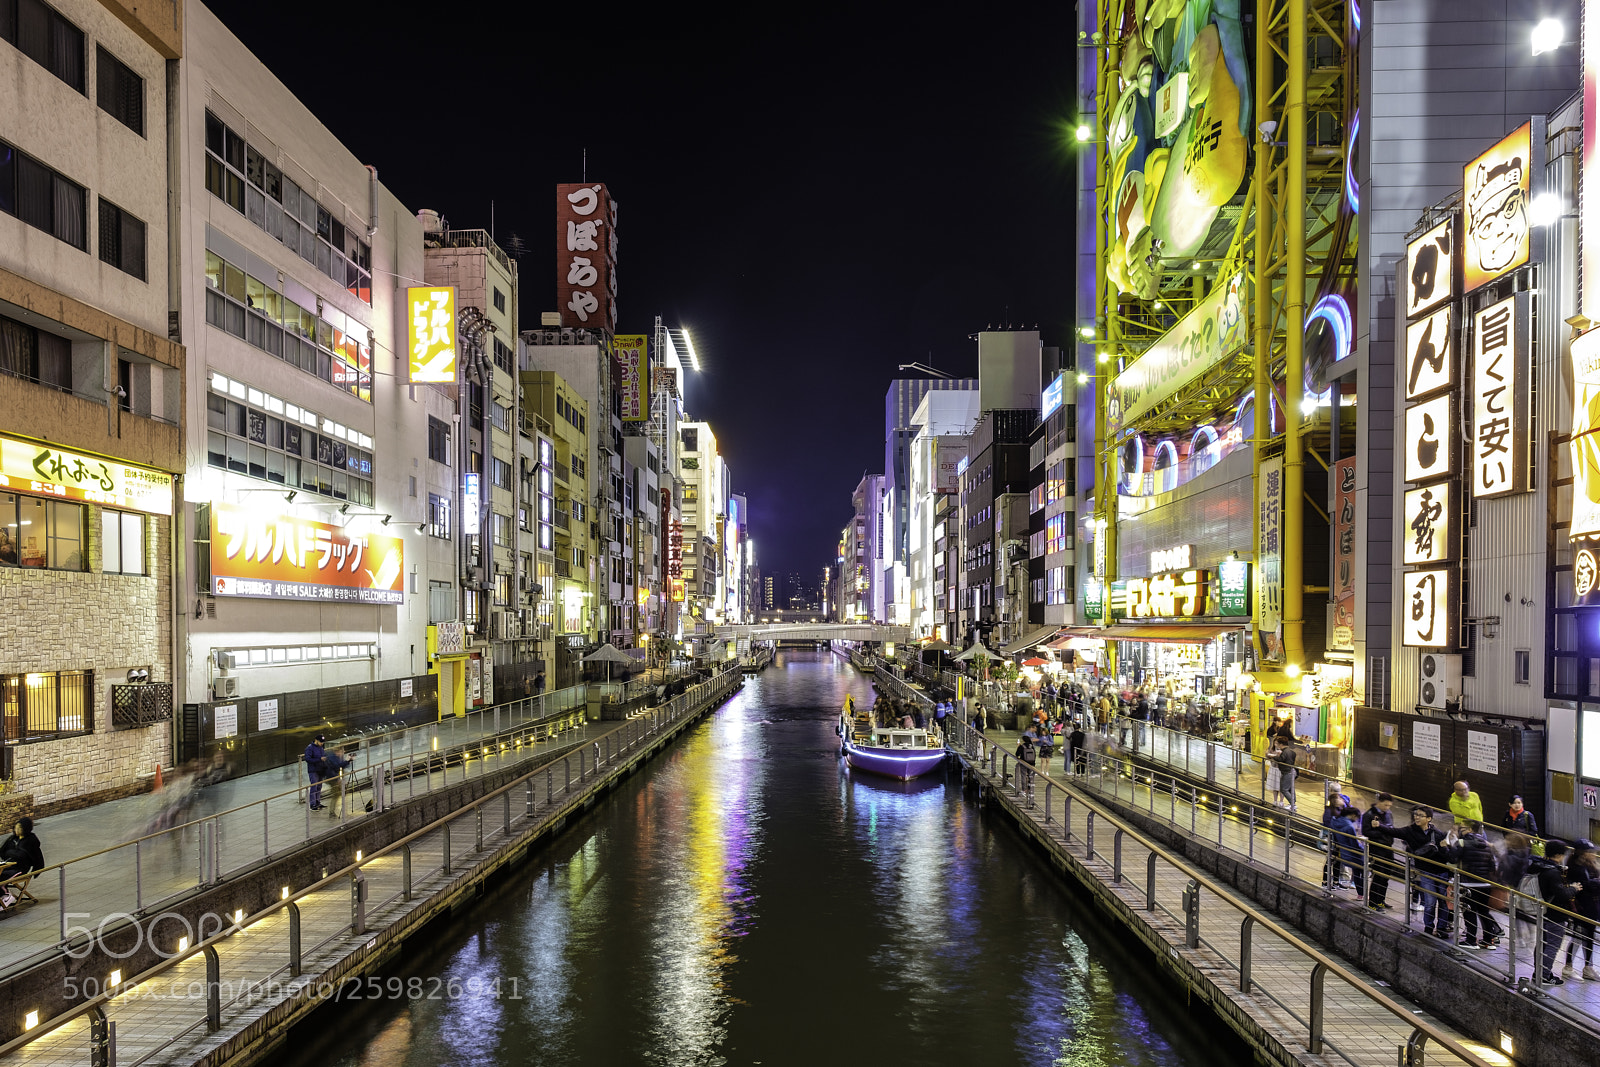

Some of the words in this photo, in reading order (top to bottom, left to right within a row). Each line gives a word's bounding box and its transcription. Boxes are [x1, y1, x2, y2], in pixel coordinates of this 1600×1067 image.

[567, 184, 604, 322] づぼらや
[630, 349, 640, 417] 高収入お仕事情報
[1478, 306, 1511, 490] 旨くて安い
[32, 449, 114, 492] くれおーる
[124, 468, 170, 486] 団体予約受付中
[1341, 466, 1356, 588] とんぼり
[299, 585, 318, 598] SALE
[358, 589, 387, 602] WELCOME
